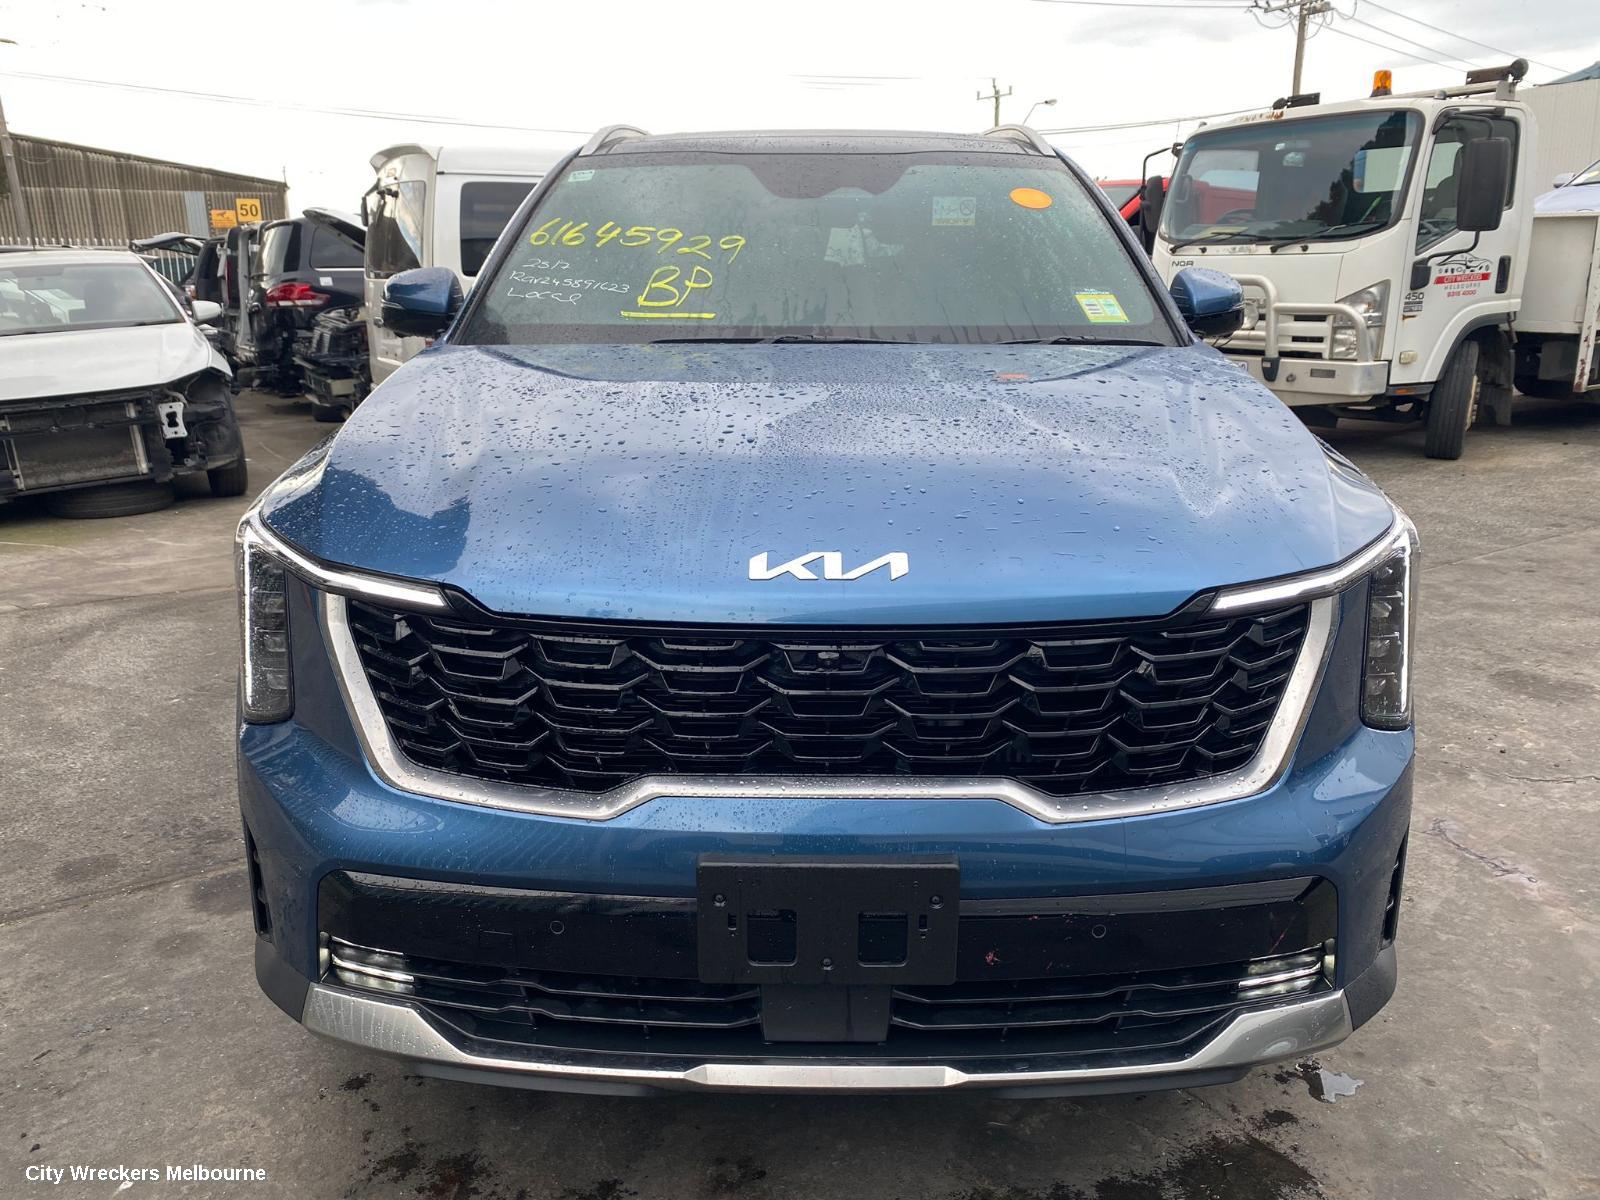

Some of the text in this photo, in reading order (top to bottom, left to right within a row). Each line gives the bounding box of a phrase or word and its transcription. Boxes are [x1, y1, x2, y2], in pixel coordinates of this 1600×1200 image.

[240, 203, 259, 217] 50
[637, 265, 713, 307] BP
[1405, 292, 1424, 301] 450
[748, 551, 909, 581] KIA
